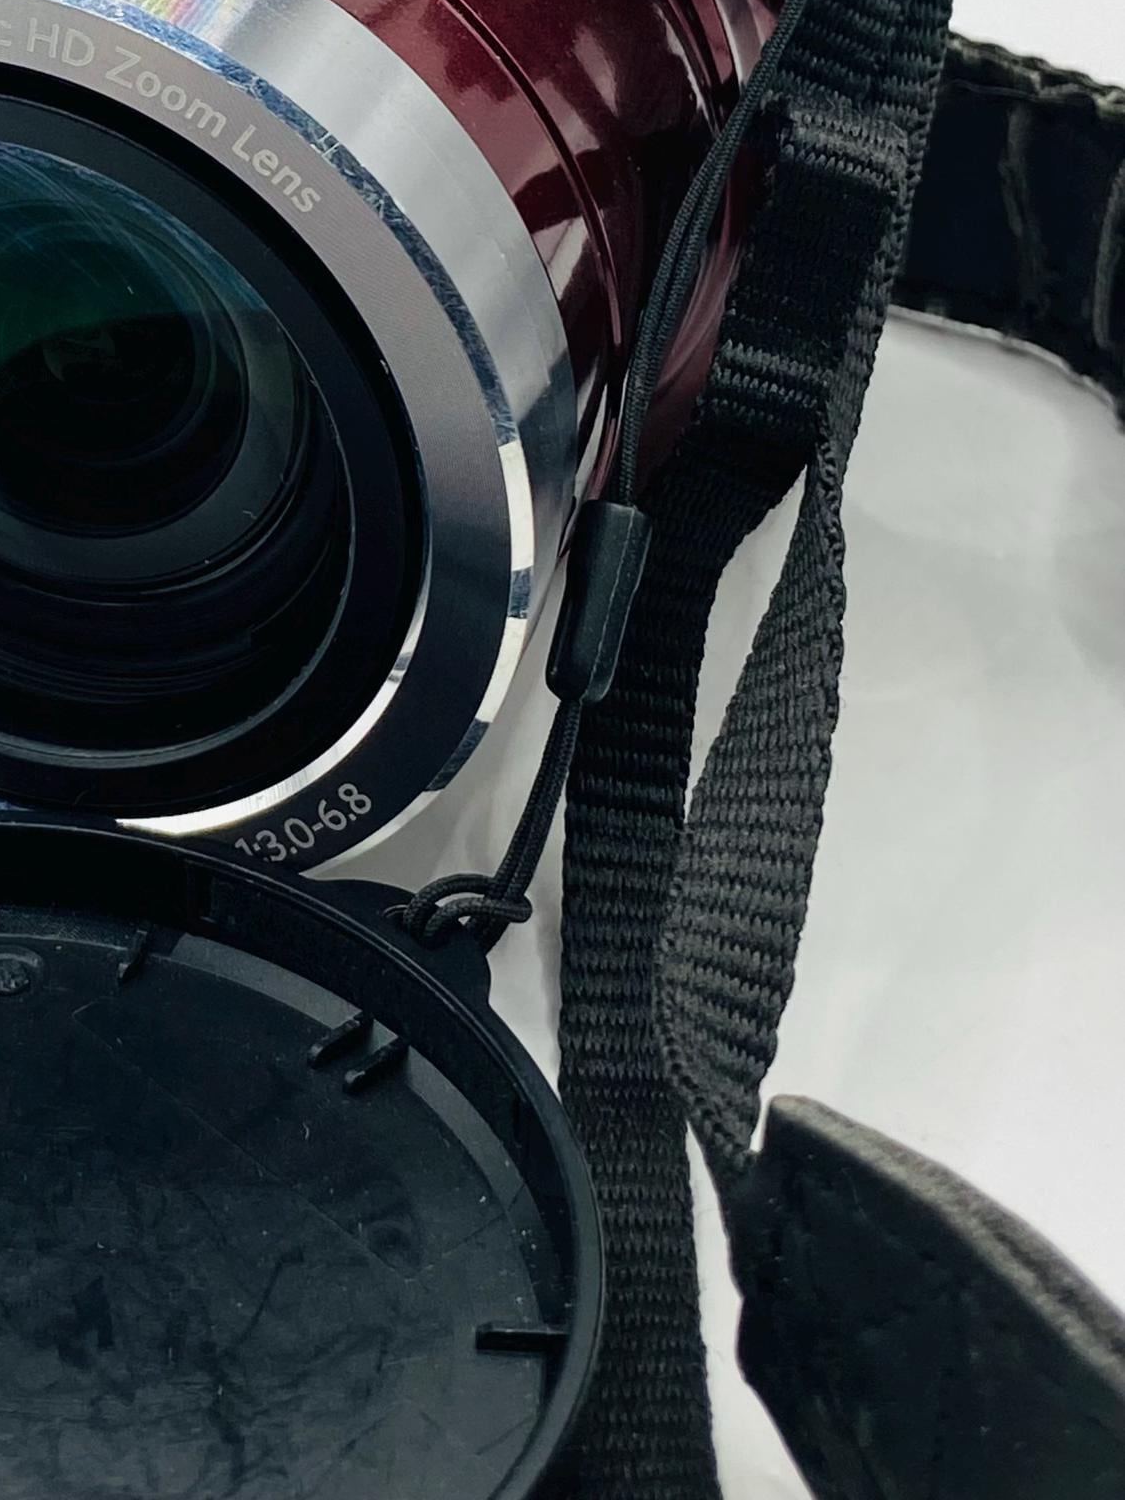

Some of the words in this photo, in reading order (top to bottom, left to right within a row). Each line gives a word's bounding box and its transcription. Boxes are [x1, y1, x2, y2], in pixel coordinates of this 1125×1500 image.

[26, 25, 96, 69] HD
[104, 45, 229, 138] Zoom
[231, 125, 322, 214] Lens
